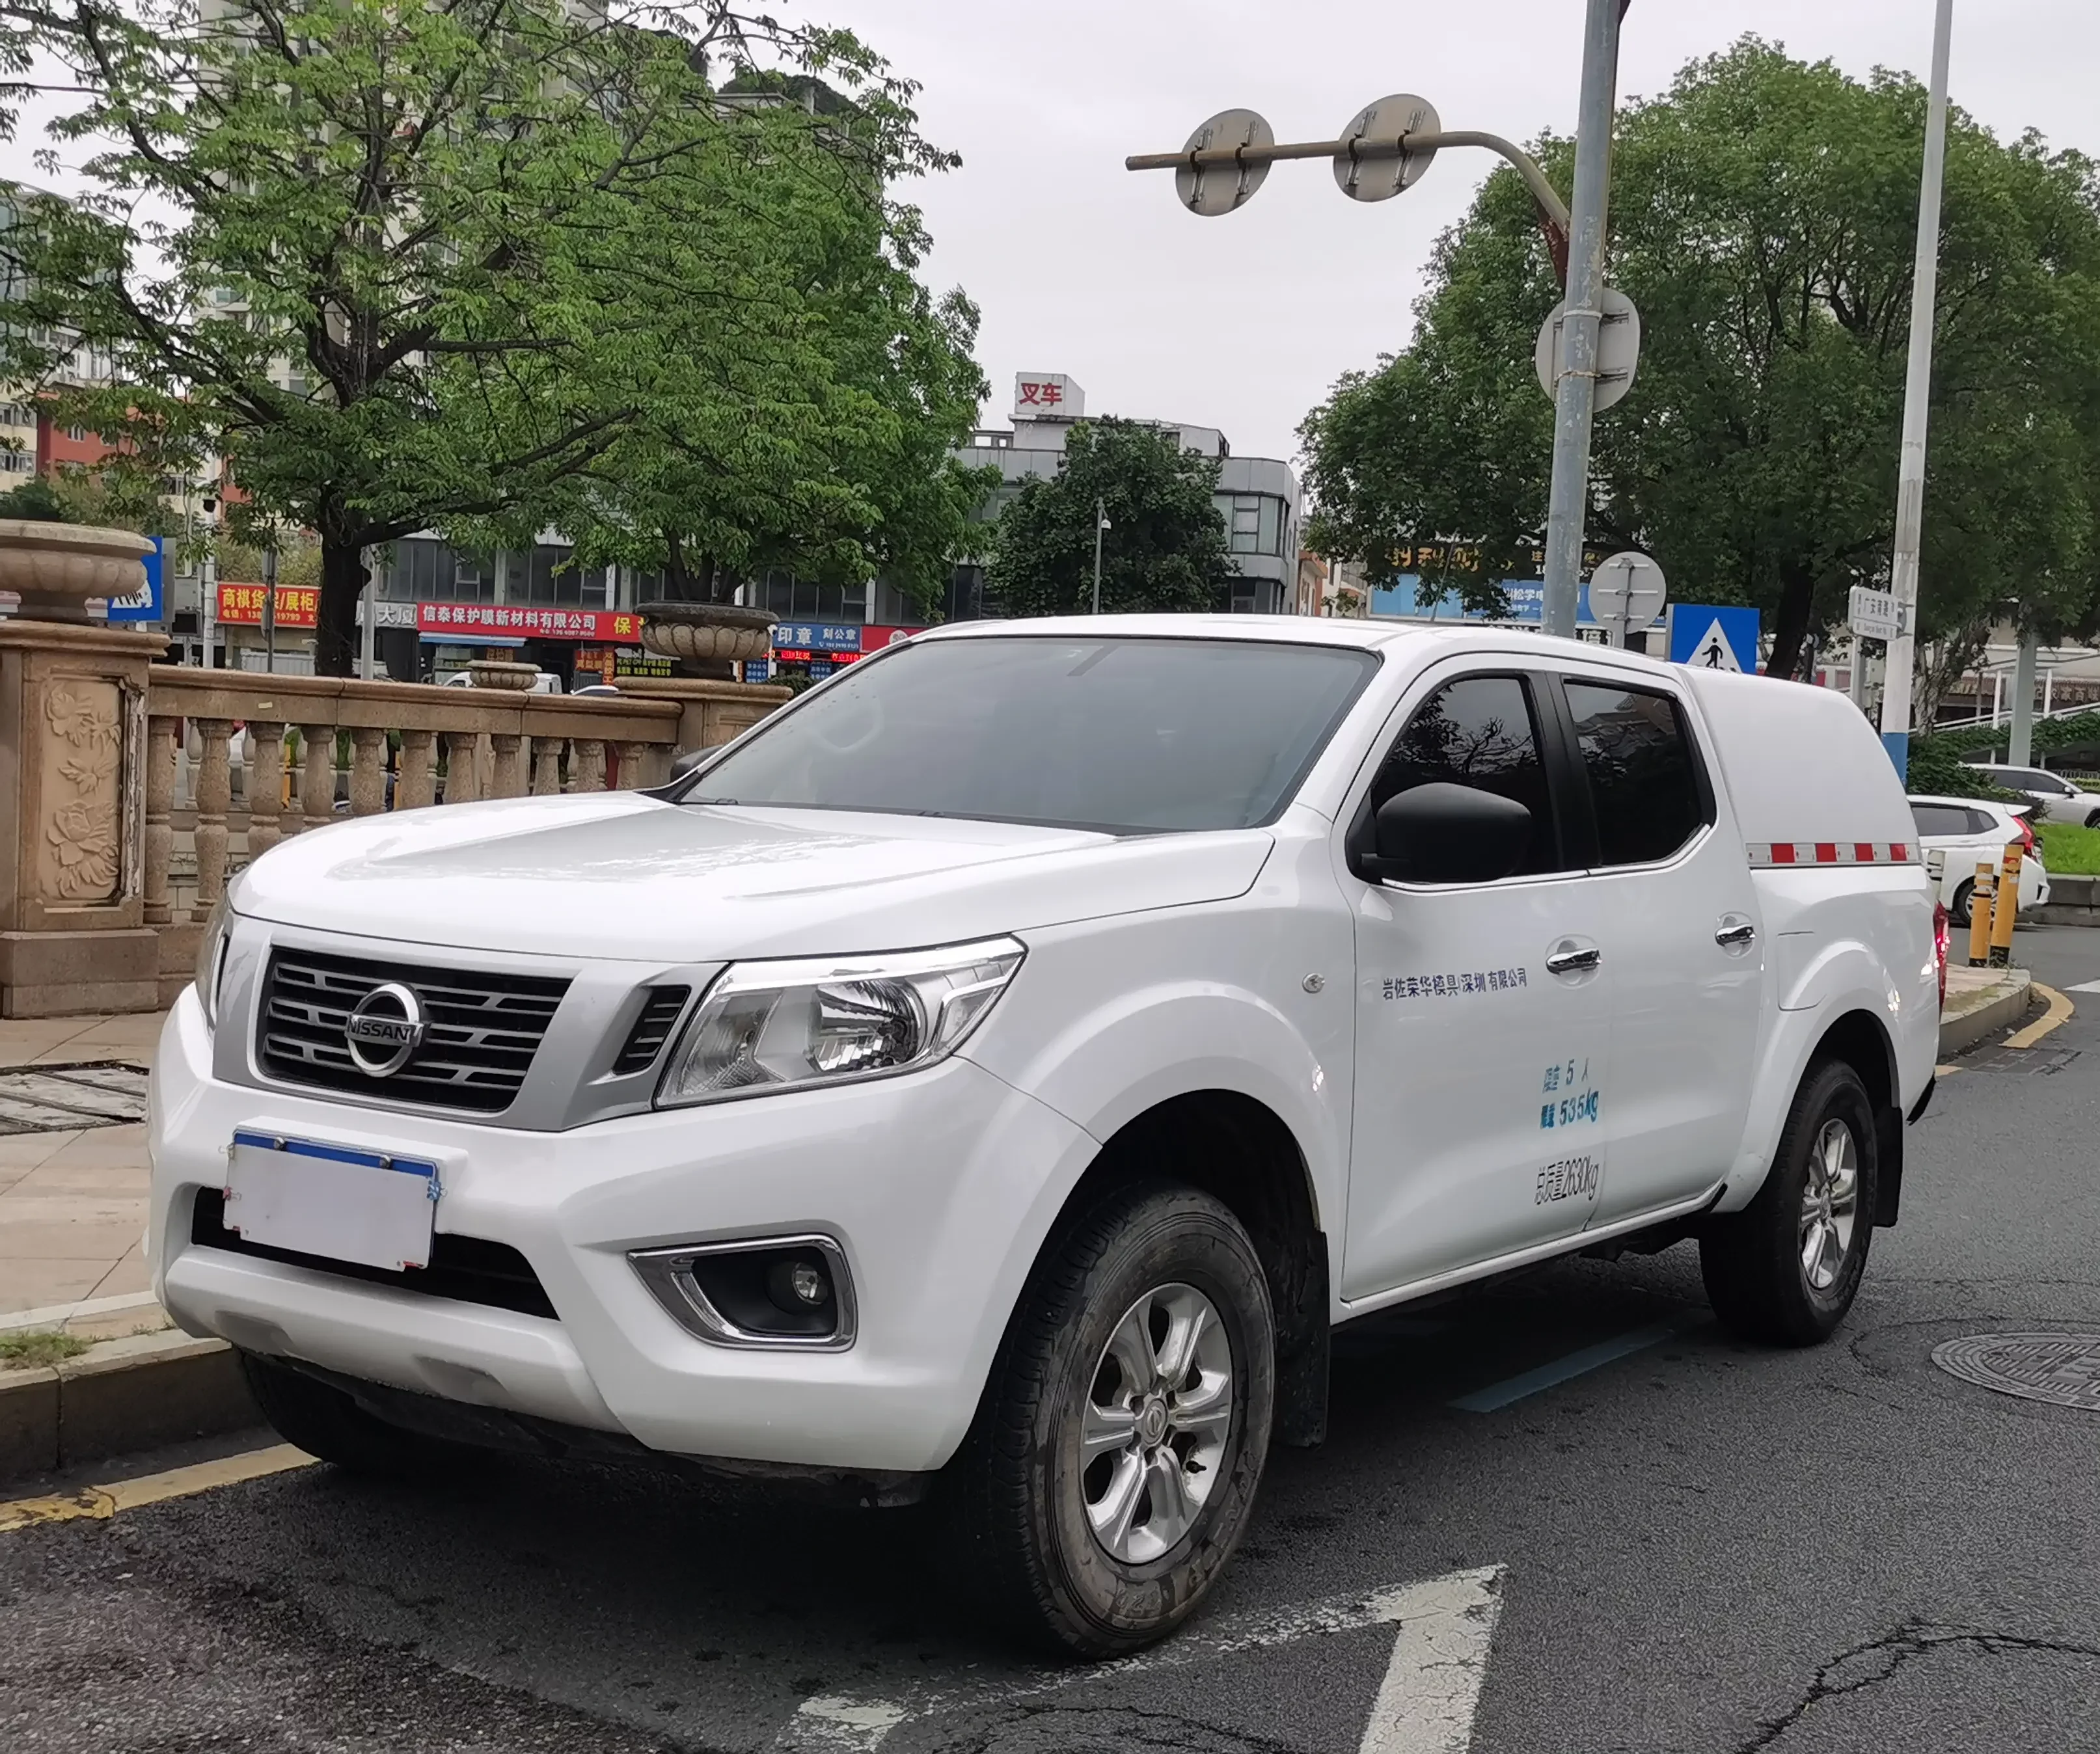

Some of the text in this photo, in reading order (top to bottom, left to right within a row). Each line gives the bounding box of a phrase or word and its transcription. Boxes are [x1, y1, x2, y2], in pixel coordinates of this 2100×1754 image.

[1018, 383, 1062, 406] 叉车
[423, 605, 595, 630] 信泰保护膜新材料有限公司
[823, 628, 856, 642] 刻公章
[346, 1017, 411, 1041] NISSAN
[1566, 1059, 1575, 1085] 5
[1559, 1086, 1600, 1126] 535kg
